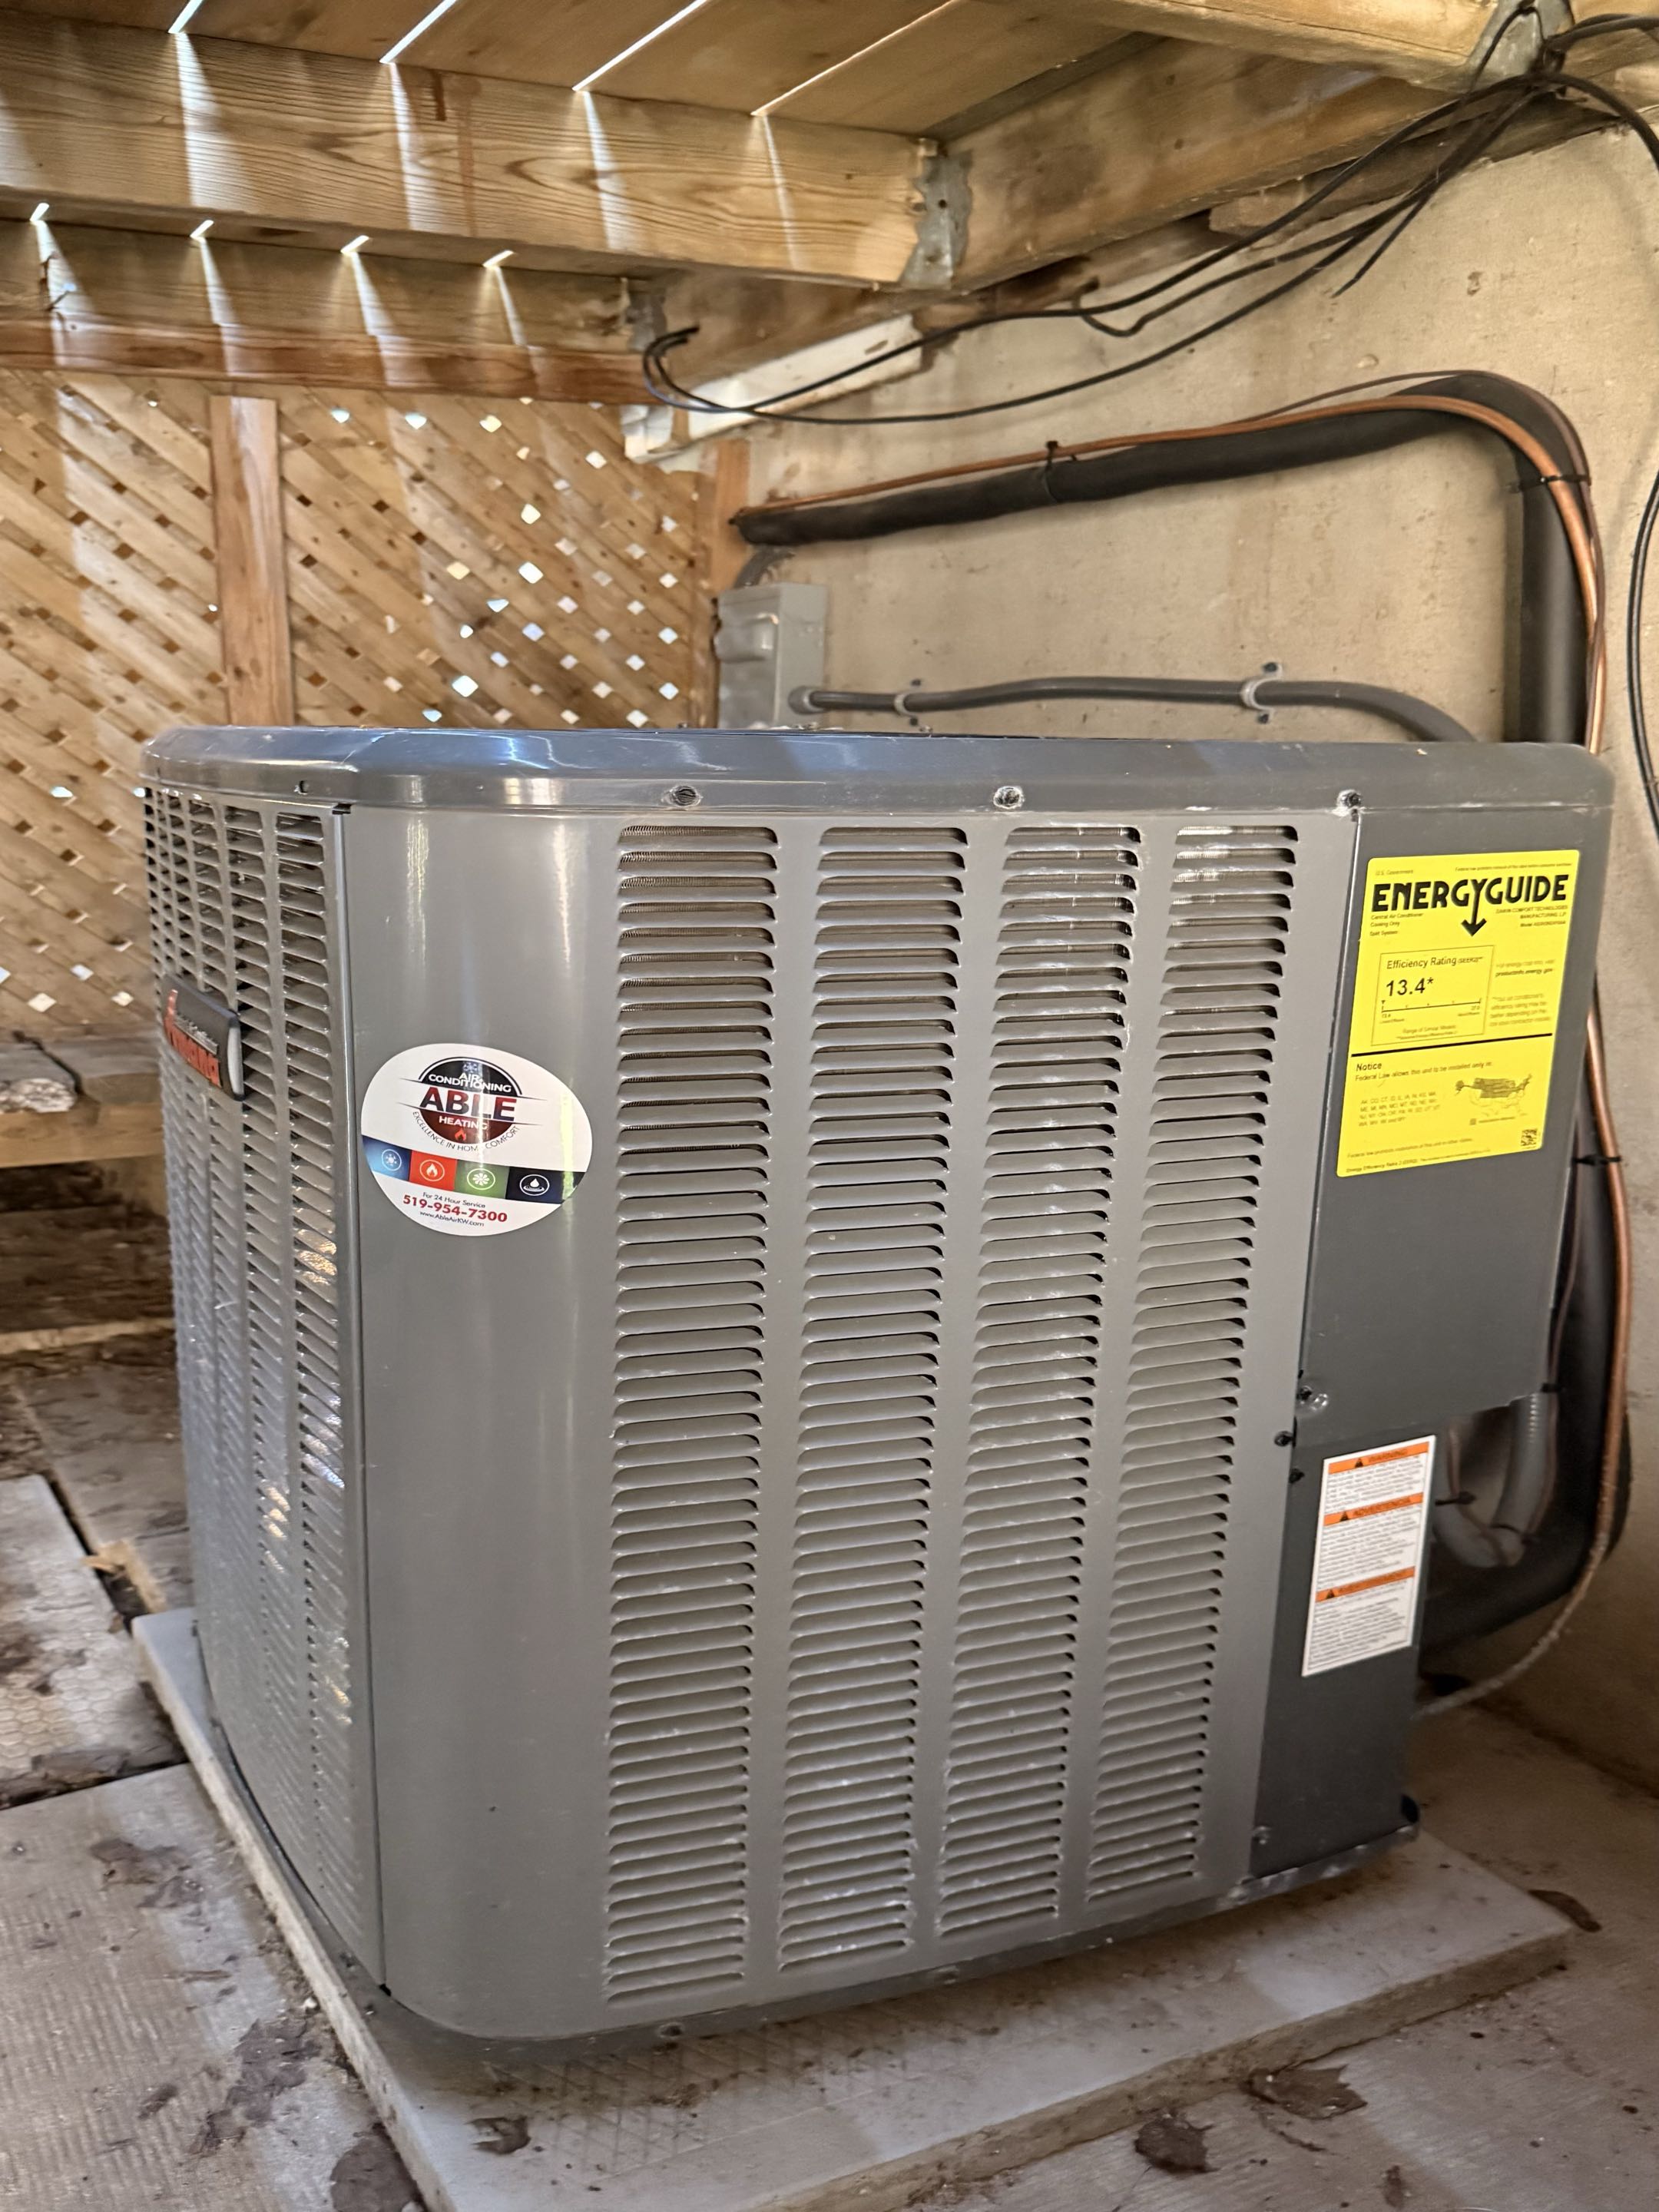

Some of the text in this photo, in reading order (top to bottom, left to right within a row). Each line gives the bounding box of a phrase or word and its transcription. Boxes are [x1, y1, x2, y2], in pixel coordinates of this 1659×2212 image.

[1371, 874, 1569, 912] ENERGYGUIDE
[1386, 959, 1429, 969] Efficiency
[1430, 956, 1457, 966] Rating
[1356, 1062, 1382, 1071] Notice
[428, 1074, 512, 1093] CONDITIONING
[419, 1086, 518, 1121] ABLE
[412, 1111, 445, 1146] EXCELLENCE
[445, 1141, 456, 1150] IN
[485, 1126, 520, 1149] COMFORT
[439, 1116, 488, 1131] HEATING
[402, 1194, 508, 1223] 519-954-7300
[444, 1197, 461, 1205] Hour
[462, 1200, 486, 1209] Service
